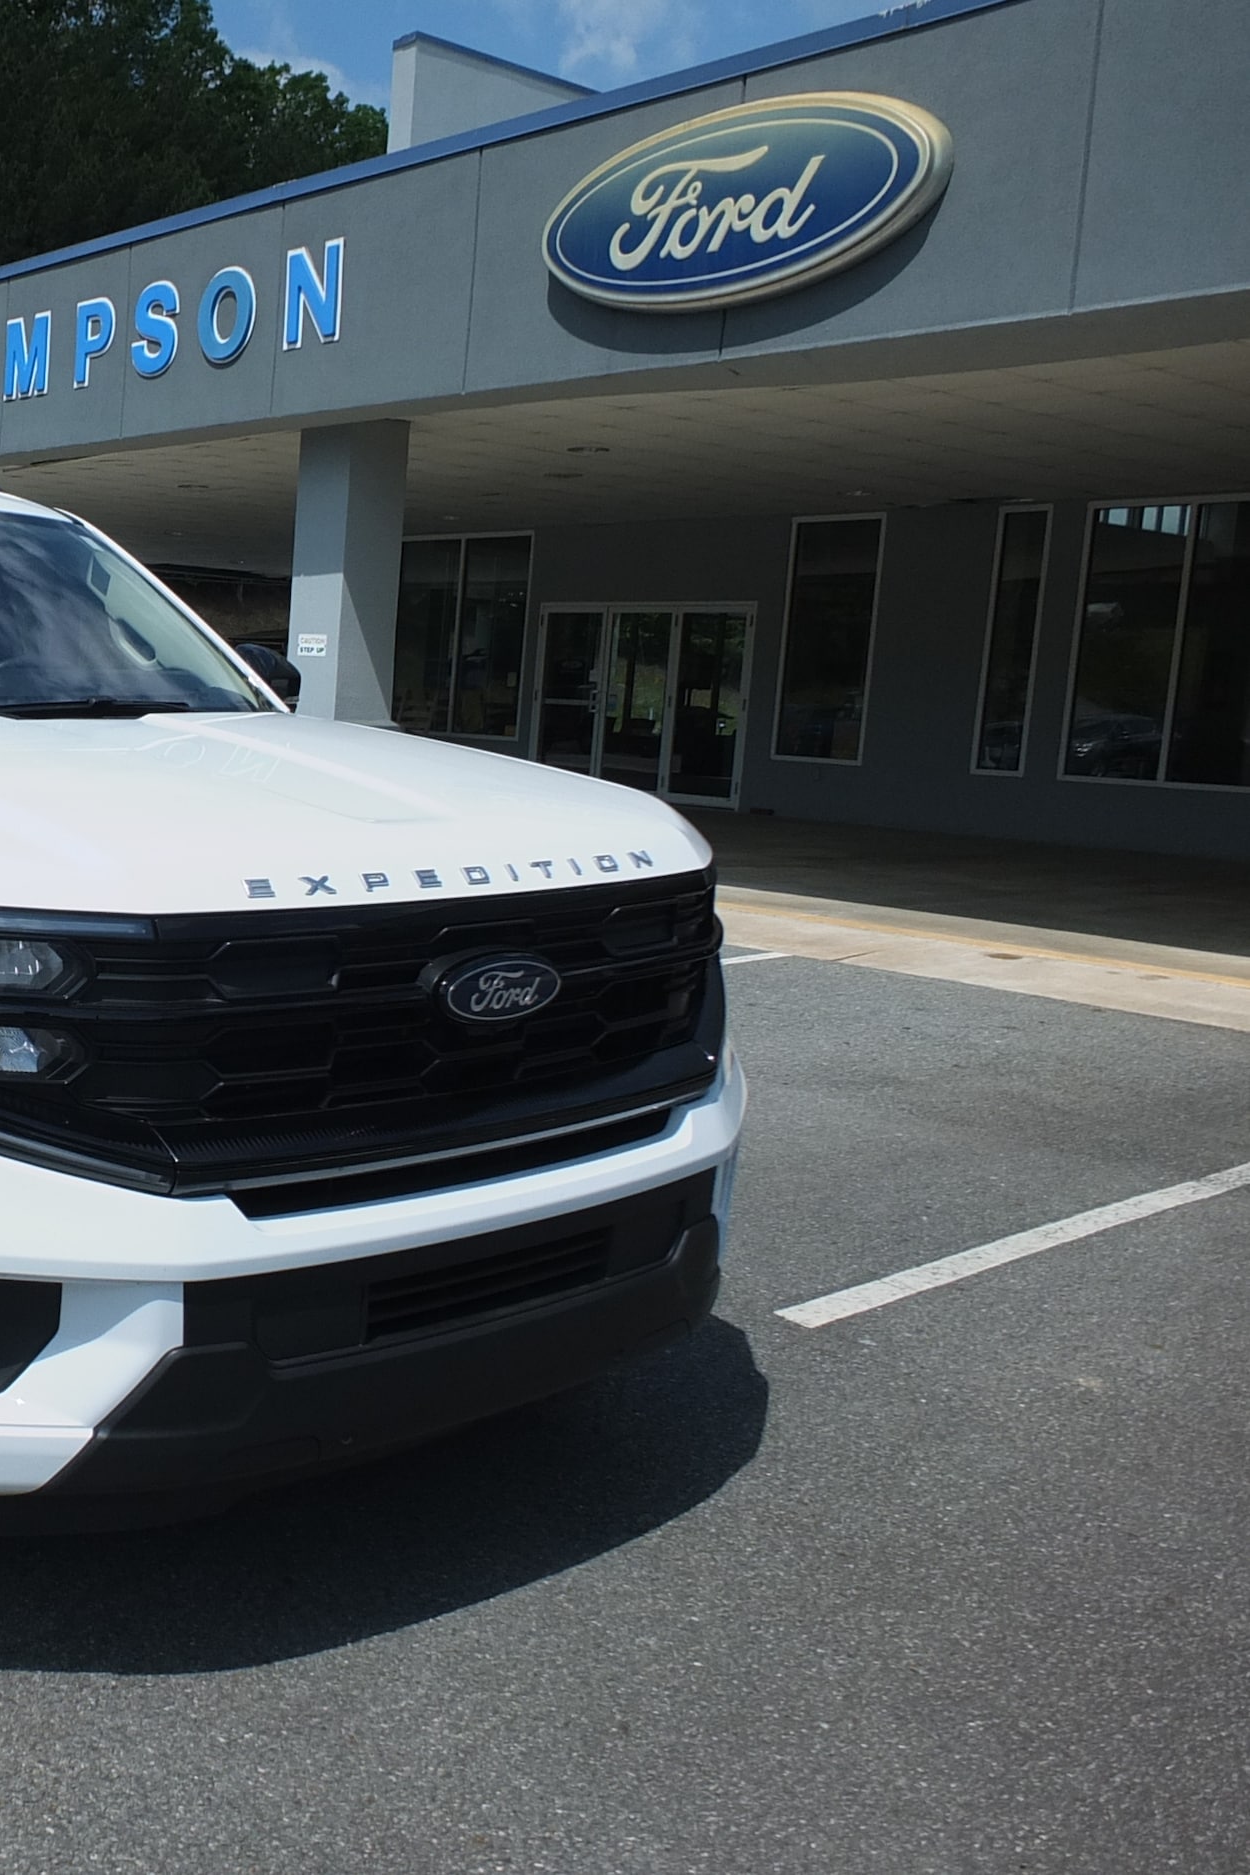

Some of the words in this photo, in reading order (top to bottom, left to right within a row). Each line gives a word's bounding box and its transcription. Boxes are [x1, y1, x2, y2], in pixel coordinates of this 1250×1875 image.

[609, 145, 825, 271] Ford
[300, 646, 315, 654] STEP
[242, 850, 653, 898] EXPEDITION
[470, 969, 541, 1012] Ford
